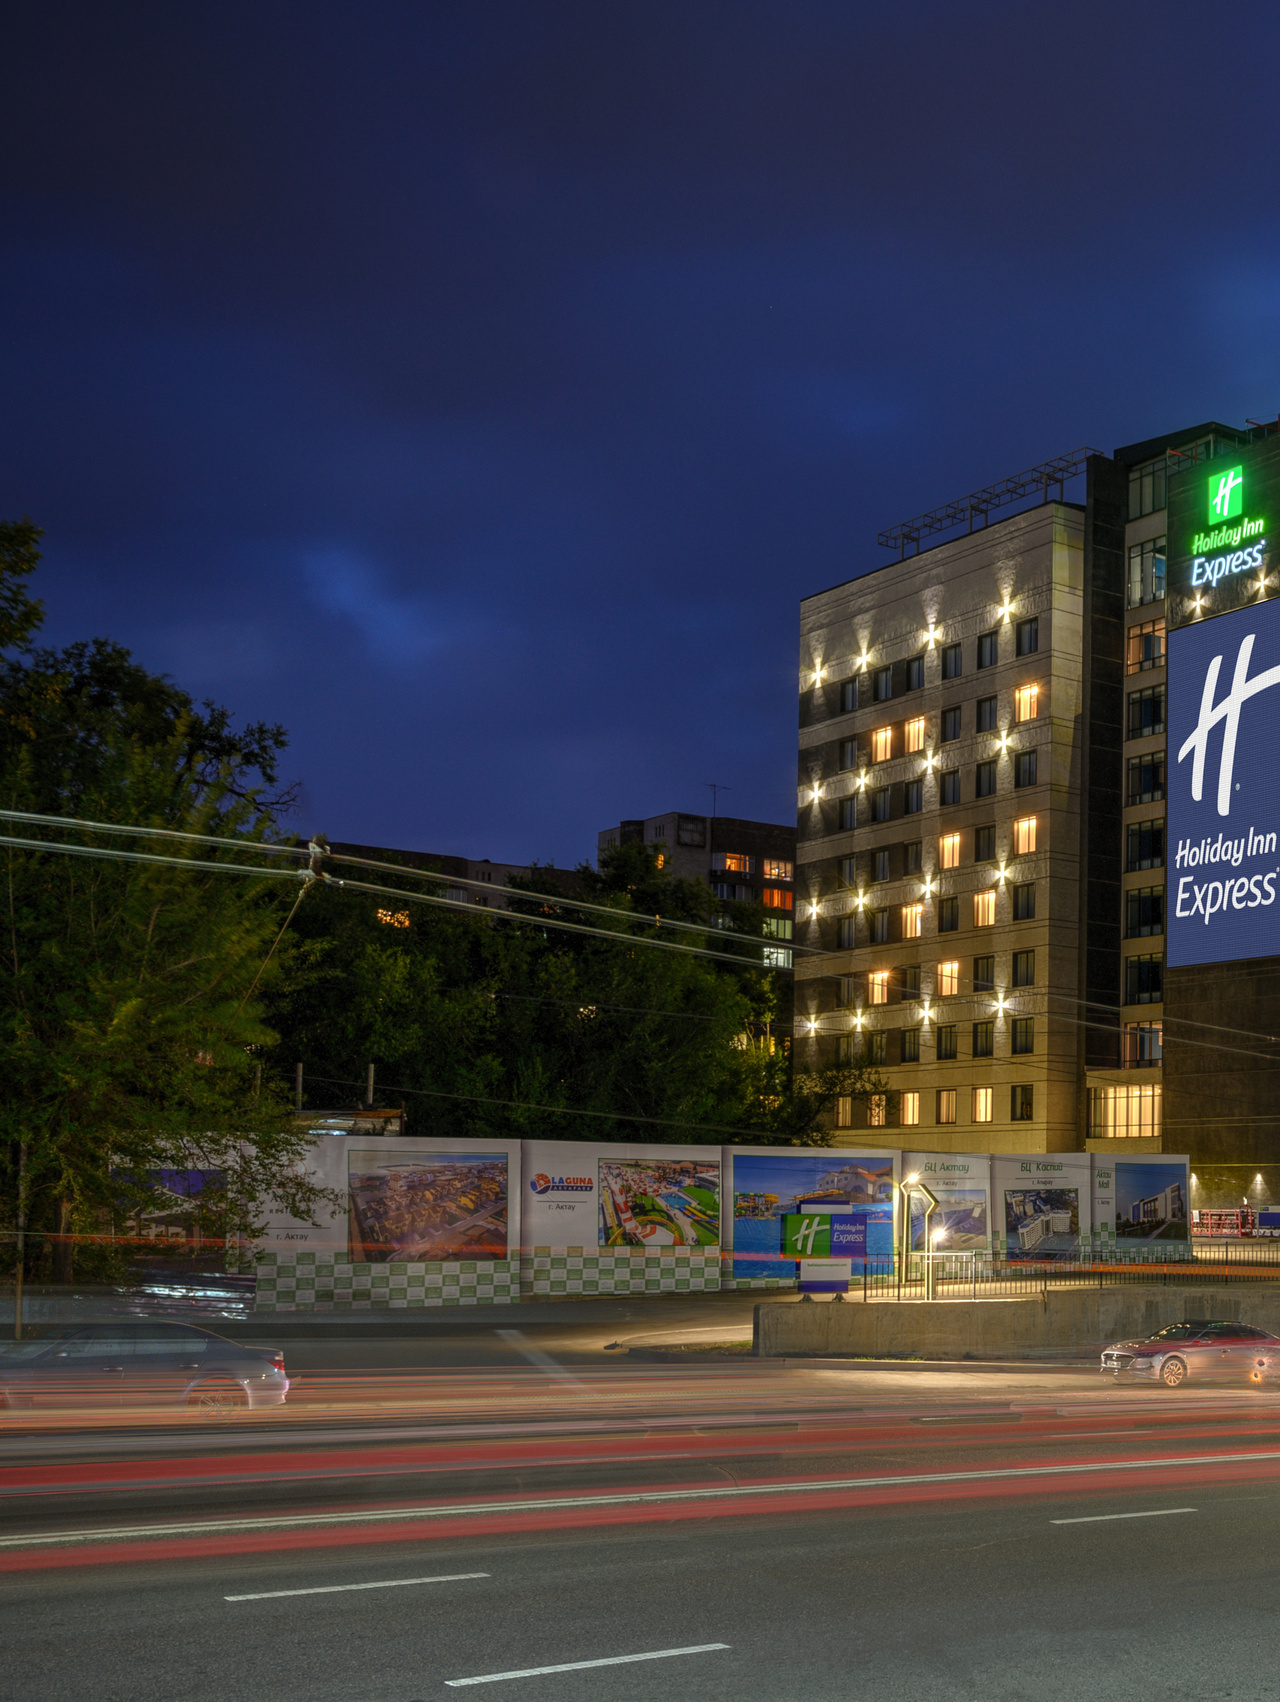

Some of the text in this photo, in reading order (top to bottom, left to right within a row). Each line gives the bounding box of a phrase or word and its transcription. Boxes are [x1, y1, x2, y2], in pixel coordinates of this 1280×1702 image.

[1193, 517, 1264, 555] Holiday Inn
[1192, 543, 1264, 587] Express
[1175, 826, 1277, 869] Holiday Inn
[1175, 871, 1278, 925] Express
[924, 1162, 970, 1174] БЦ Актау
[1020, 1162, 1063, 1174] БЦ Каспий
[551, 1176, 594, 1185] LAGUNA
[555, 1203, 576, 1211] Актау
[833, 1223, 856, 1232] Holiday
[284, 1233, 309, 1241] Актау
[833, 1232, 864, 1244] Express
